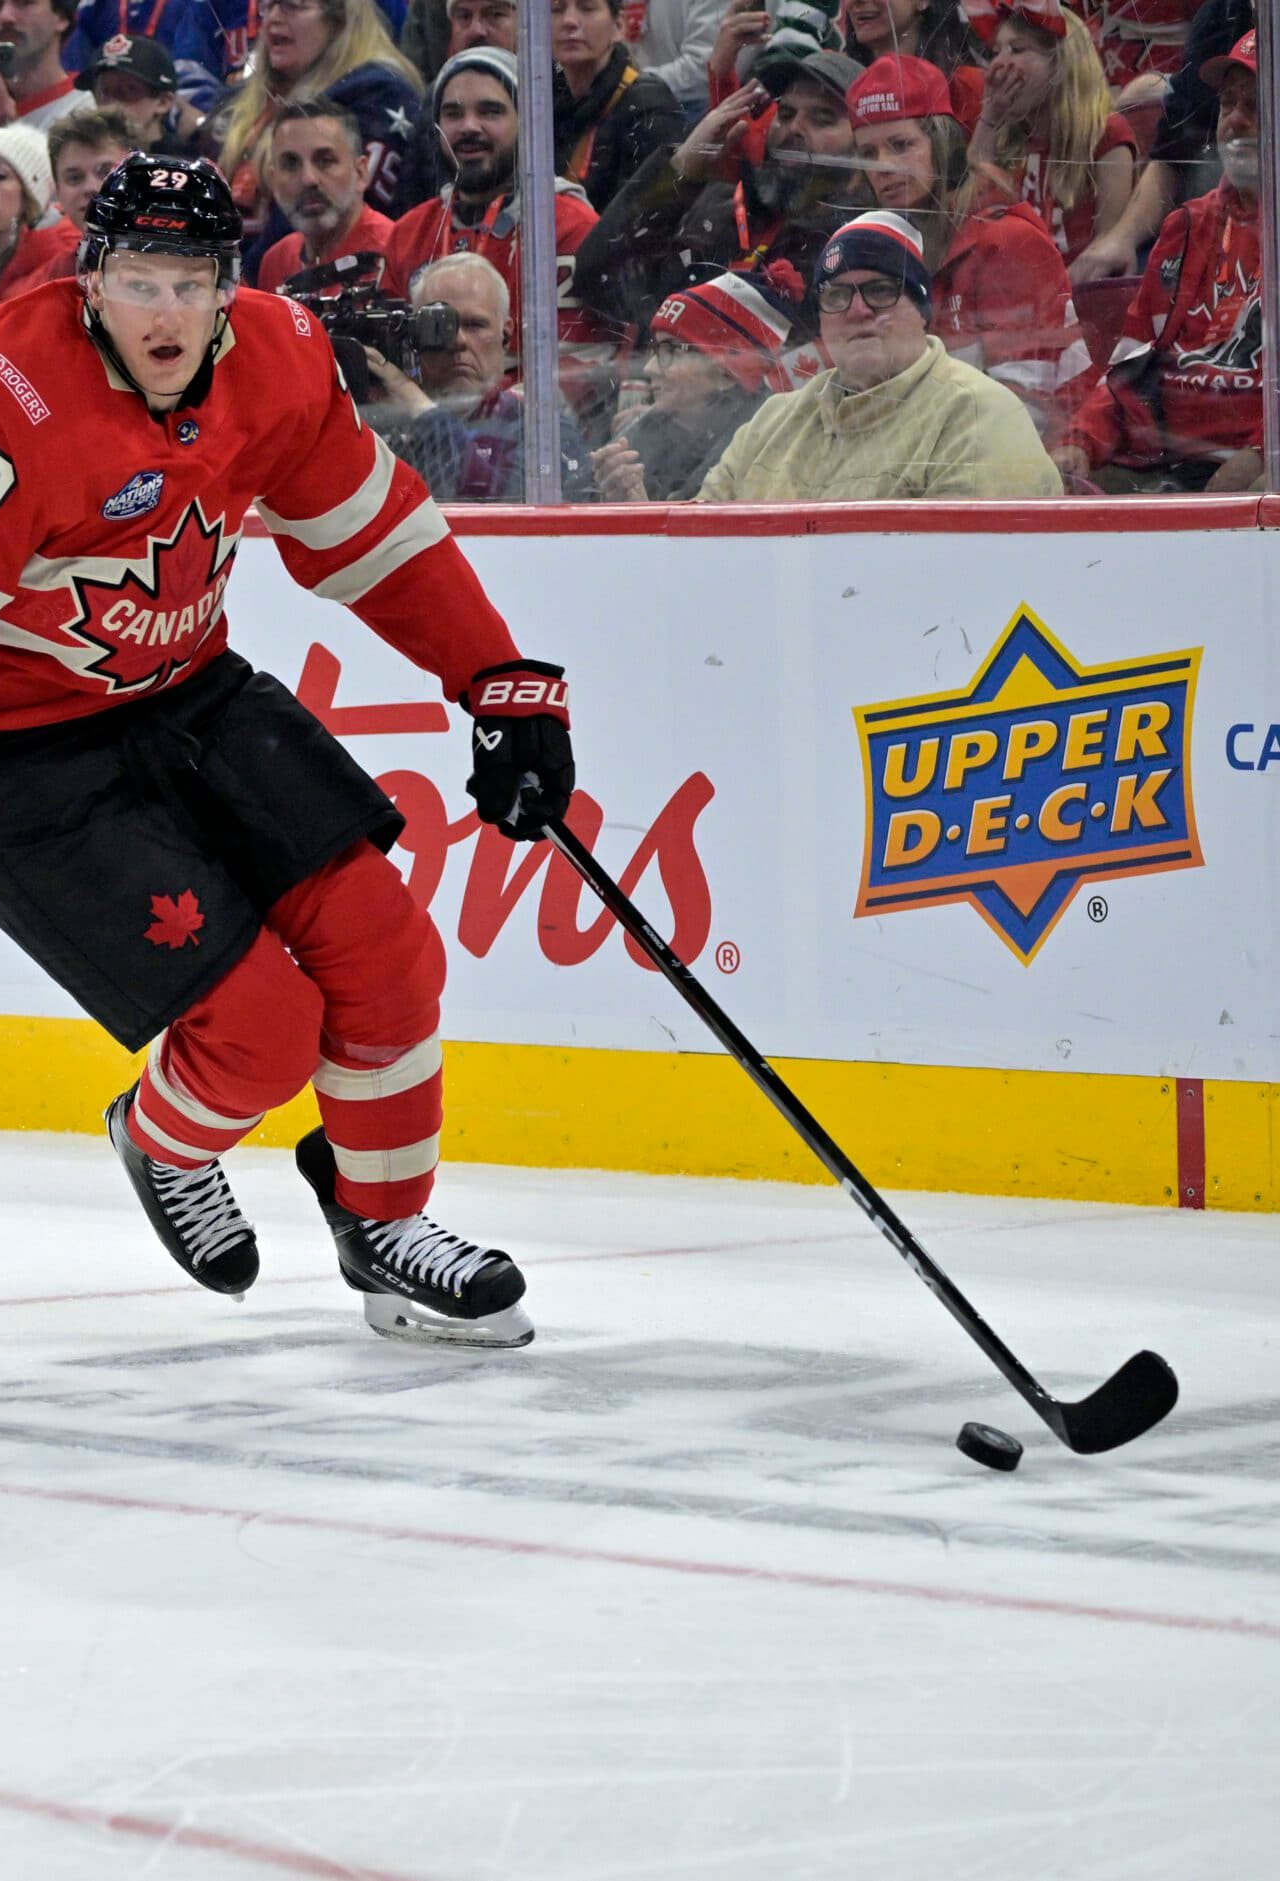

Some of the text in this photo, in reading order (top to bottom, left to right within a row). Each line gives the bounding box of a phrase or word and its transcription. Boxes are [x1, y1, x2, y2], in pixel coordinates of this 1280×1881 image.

[881, 101, 900, 112] SALE
[149, 169, 189, 189] 29
[134, 215, 187, 230] CCM
[655, 299, 686, 324] SA
[0, 367, 46, 420] ROGERS
[104, 473, 163, 508] NATIONS
[480, 681, 569, 708] BAU
[882, 701, 1172, 799] UPPER
[370, 1262, 417, 1294] CCM
